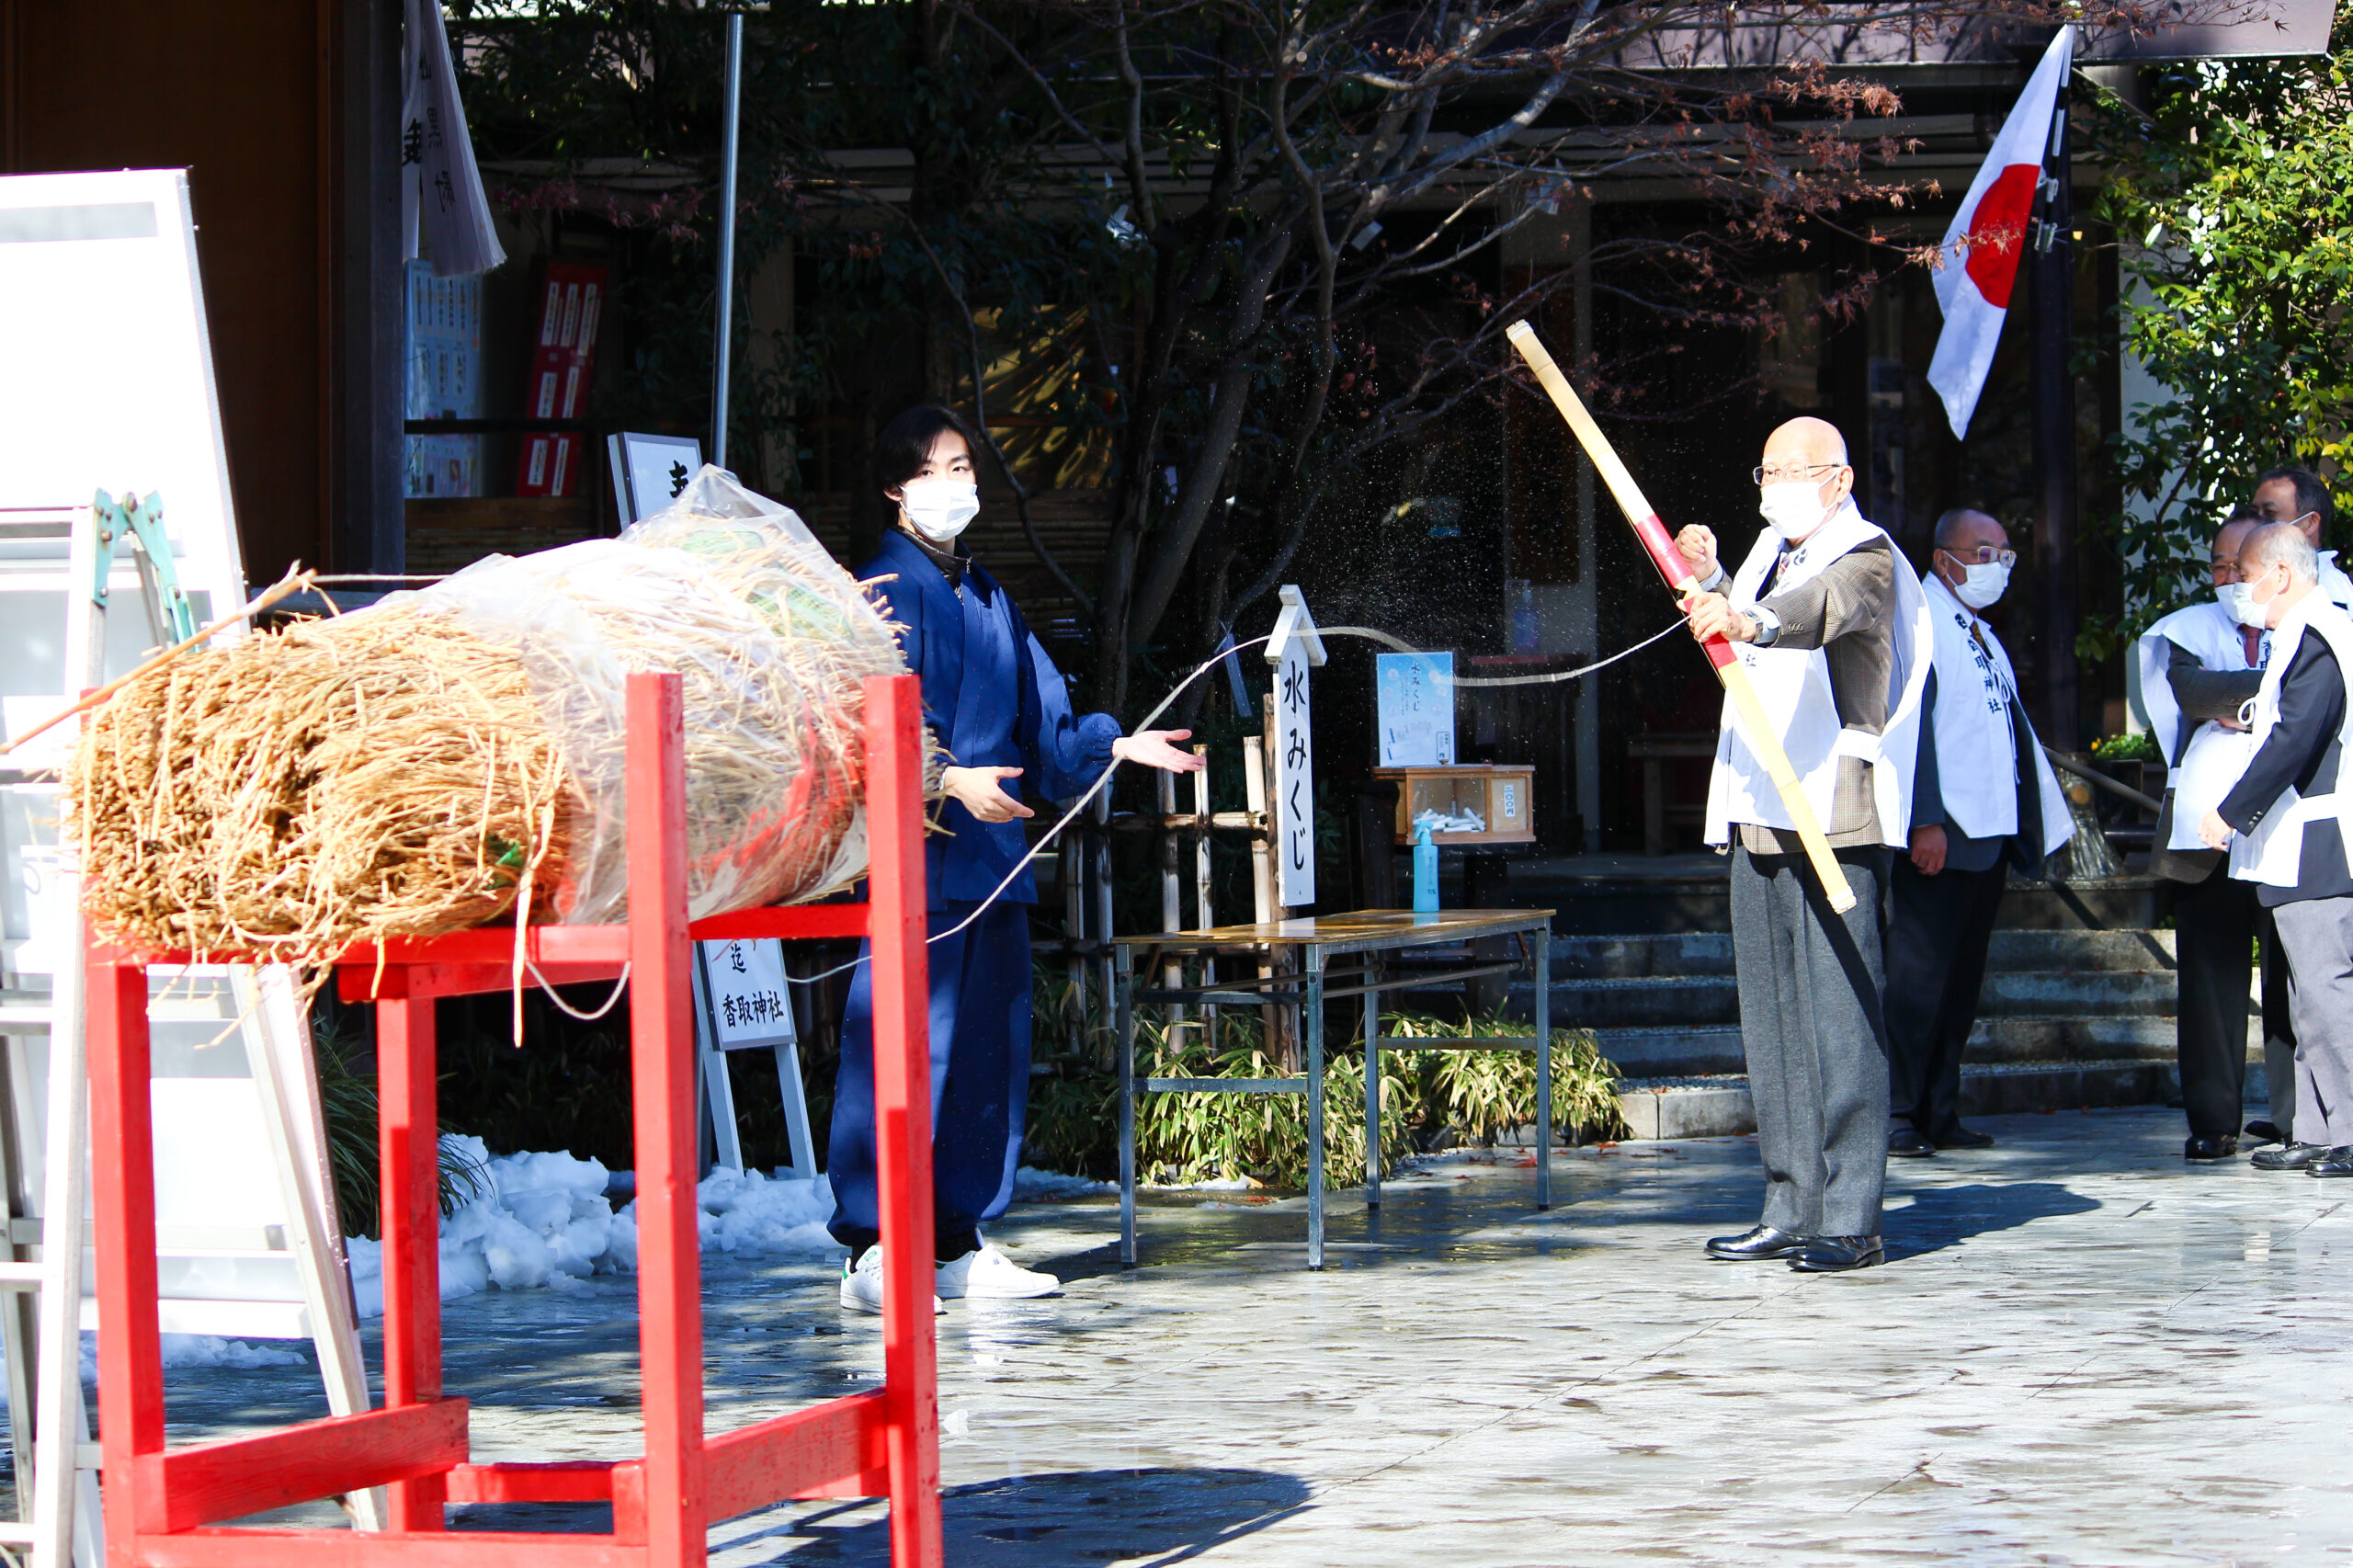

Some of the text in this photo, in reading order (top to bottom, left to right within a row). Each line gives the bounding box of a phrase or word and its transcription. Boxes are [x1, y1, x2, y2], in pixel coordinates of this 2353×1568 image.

[1411, 663, 1421, 712] 水みくじ
[1283, 659, 1307, 871] 水みくじ
[722, 990, 785, 1028] 香取神社
